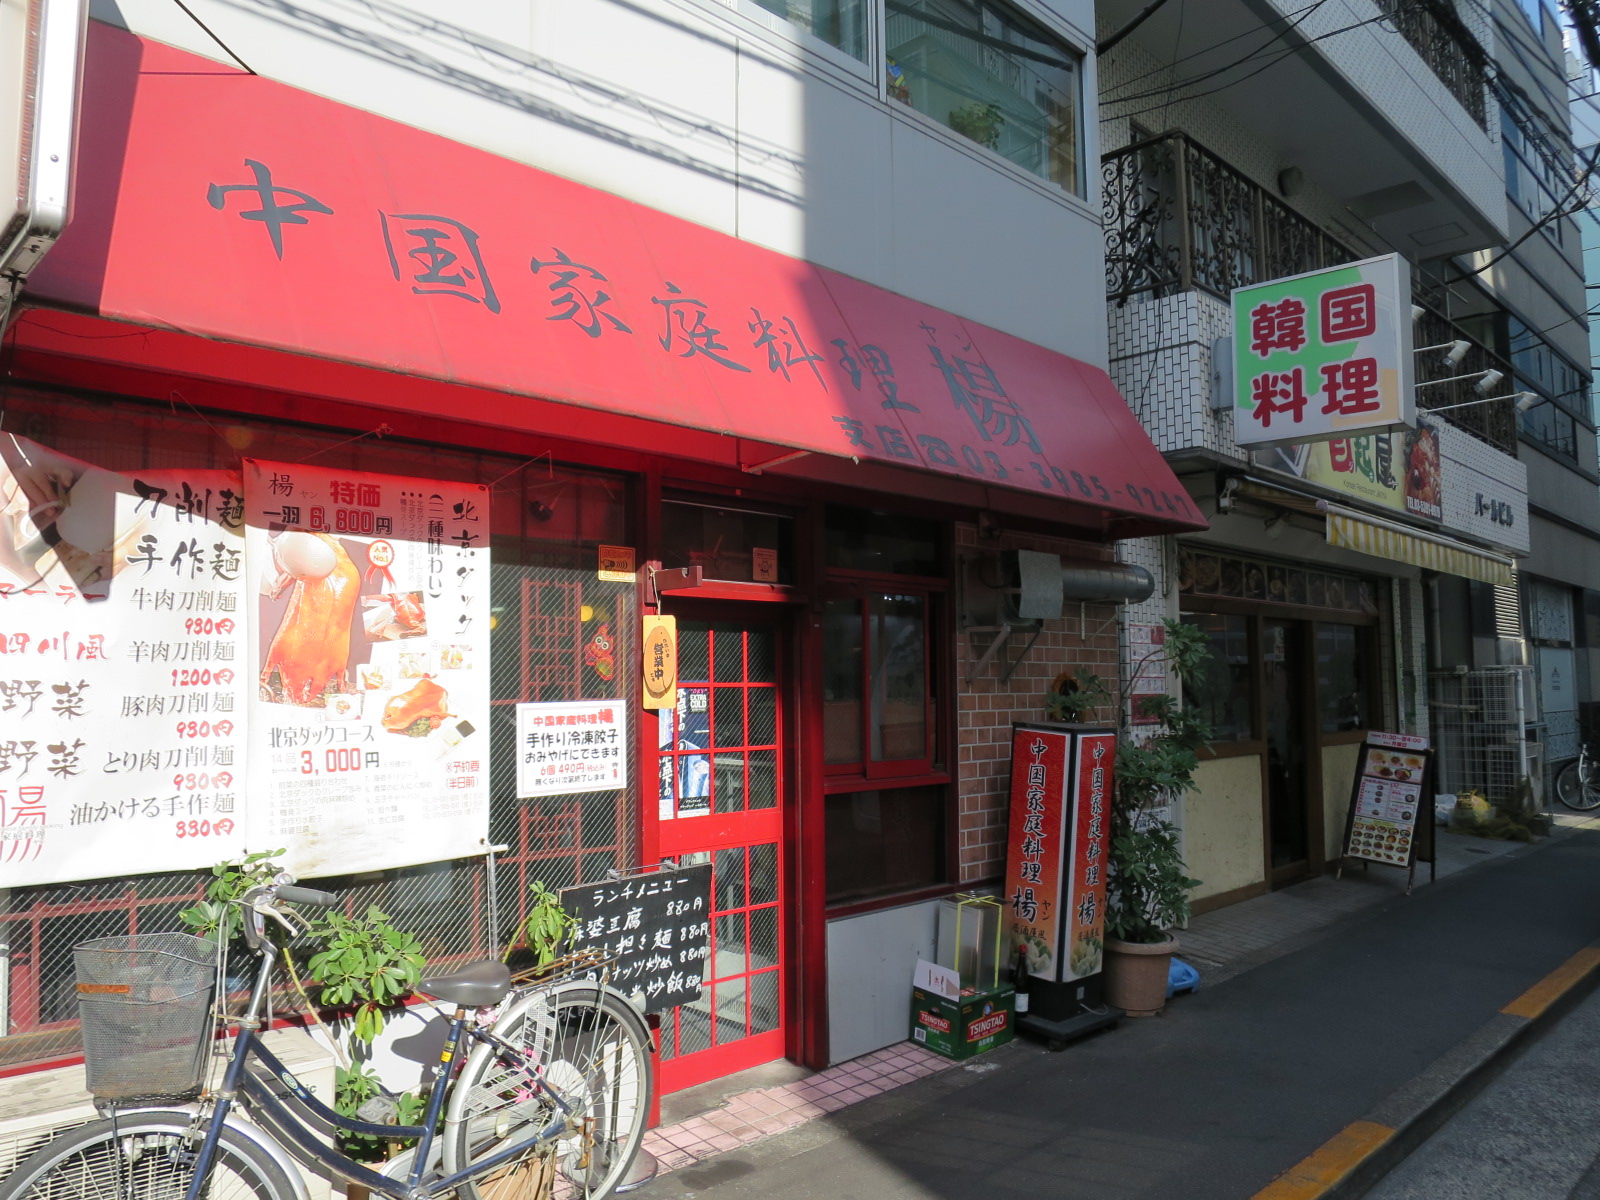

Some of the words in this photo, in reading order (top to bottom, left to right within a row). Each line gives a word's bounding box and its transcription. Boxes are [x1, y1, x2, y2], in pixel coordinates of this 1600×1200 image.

[1252, 284, 1376, 357] 韓国
[919, 320, 972, 352] ヤン
[1253, 358, 1380, 428] 料理
[133, 478, 245, 529] 刀削麺
[268, 472, 294, 497] 楊
[330, 480, 381, 508] 特価
[263, 505, 300, 525] 一羽
[309, 505, 393, 535] 6,800円
[126, 534, 242, 582] 手作麺
[374, 545, 388, 553] 人気
[451, 498, 480, 635] 北京ダック
[130, 587, 238, 612] 牛肉刀削麺
[127, 640, 235, 663] 羊肉刀削麺
[654, 643, 664, 680] 営業中
[171, 668, 235, 687] 1200円
[0, 679, 91, 720] 野菜
[120, 691, 234, 718] 豚肉刀削麺
[690, 700, 707, 708] COLD
[268, 725, 375, 748] 北京ダックコース
[526, 729, 619, 749] 手作り冷凍餃子
[0, 738, 88, 779] 野菜
[103, 745, 234, 773] とり肉刀削麺
[525, 746, 619, 764] おみやげにできます
[70, 792, 235, 826] 油かける手作麺
[593, 879, 689, 907] ランチメニュー
[1012, 885, 1038, 924] 楊
[1077, 890, 1096, 925] 楊
[921, 1013, 948, 1029] TSINGTAO
[970, 1014, 1004, 1036] TSINGTAO
